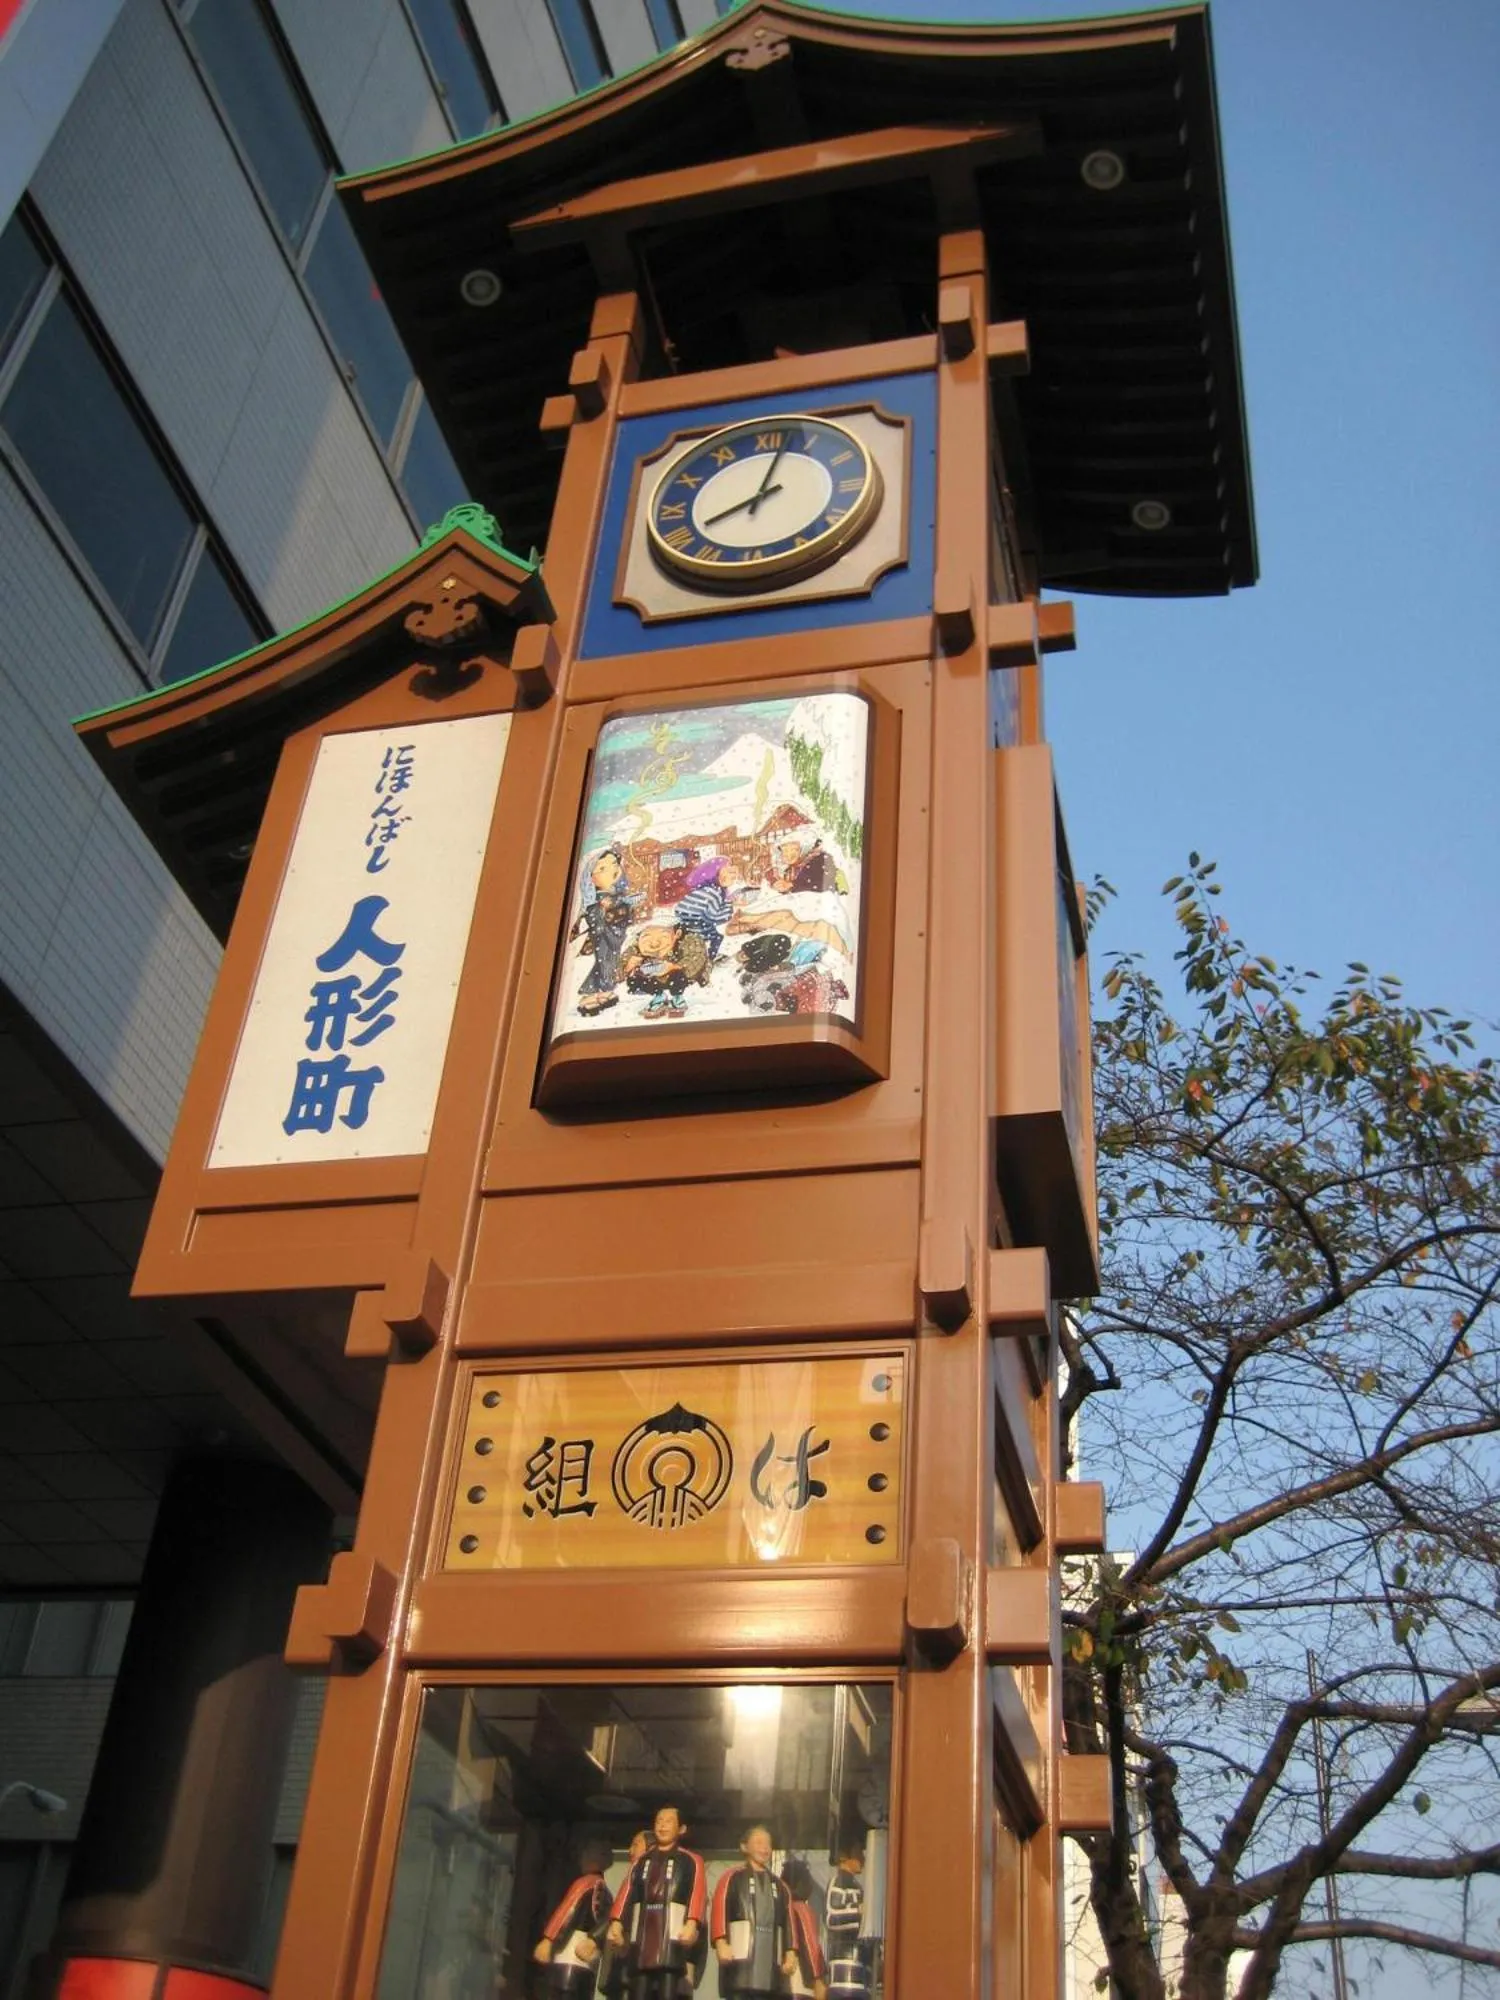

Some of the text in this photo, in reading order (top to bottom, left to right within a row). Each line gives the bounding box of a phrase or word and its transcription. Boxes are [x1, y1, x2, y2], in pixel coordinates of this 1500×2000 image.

[755, 432, 782, 451] XII
[709, 445, 736, 467] XI
[830, 449, 855, 467] II
[675, 472, 704, 489] X
[838, 478, 864, 493] III
[660, 501, 687, 520] IX
[282, 744, 416, 1136] にほんばし 人形町
[522, 1436, 599, 1519] 組
